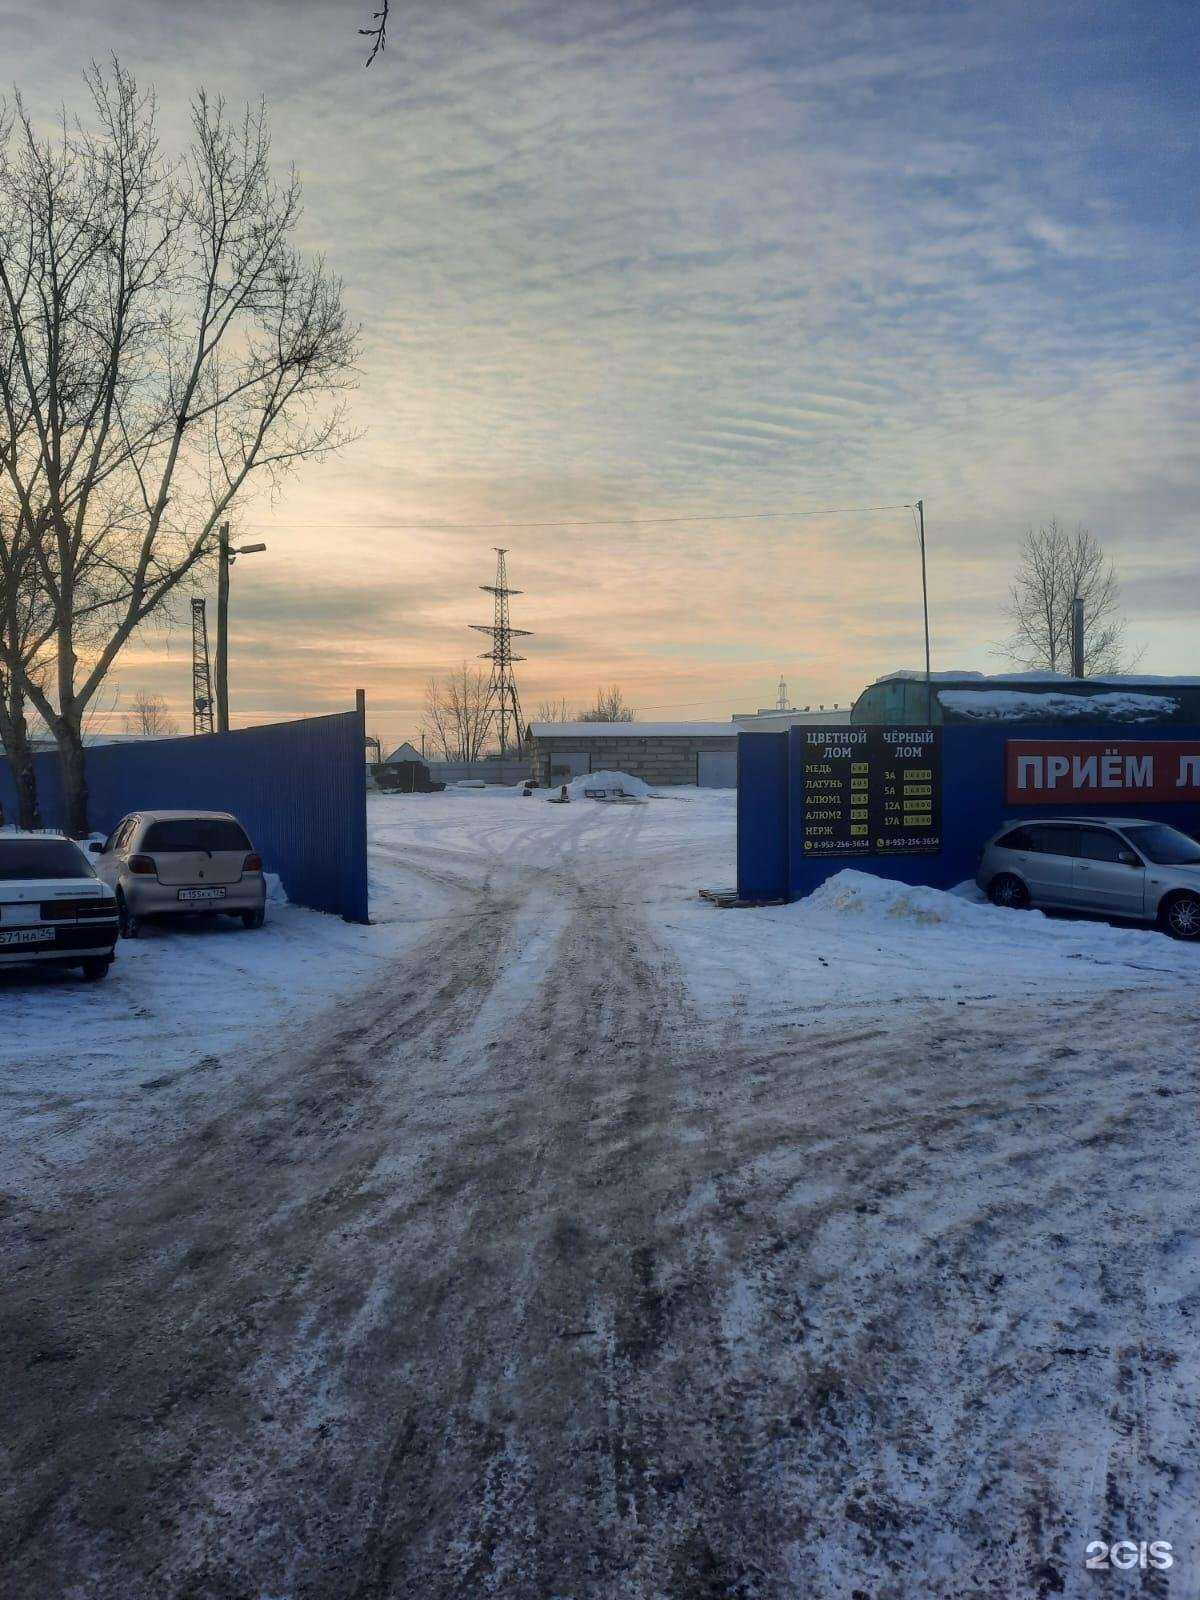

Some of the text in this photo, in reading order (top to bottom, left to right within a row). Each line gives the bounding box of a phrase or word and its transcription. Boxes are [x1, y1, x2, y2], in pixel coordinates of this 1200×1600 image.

[806, 728, 867, 746] ЦВЕТНОЙ
[883, 729, 934, 743] ЧЁРНЫЙ
[823, 747, 852, 758] ЛОМ
[895, 747, 922, 758] ЛОМ
[805, 764, 832, 774] МЕДЬ
[1017, 749, 1153, 788] ПРИЁМ
[805, 780, 843, 789] ЛАТУНЬ
[806, 826, 833, 835] НЕРЖ
